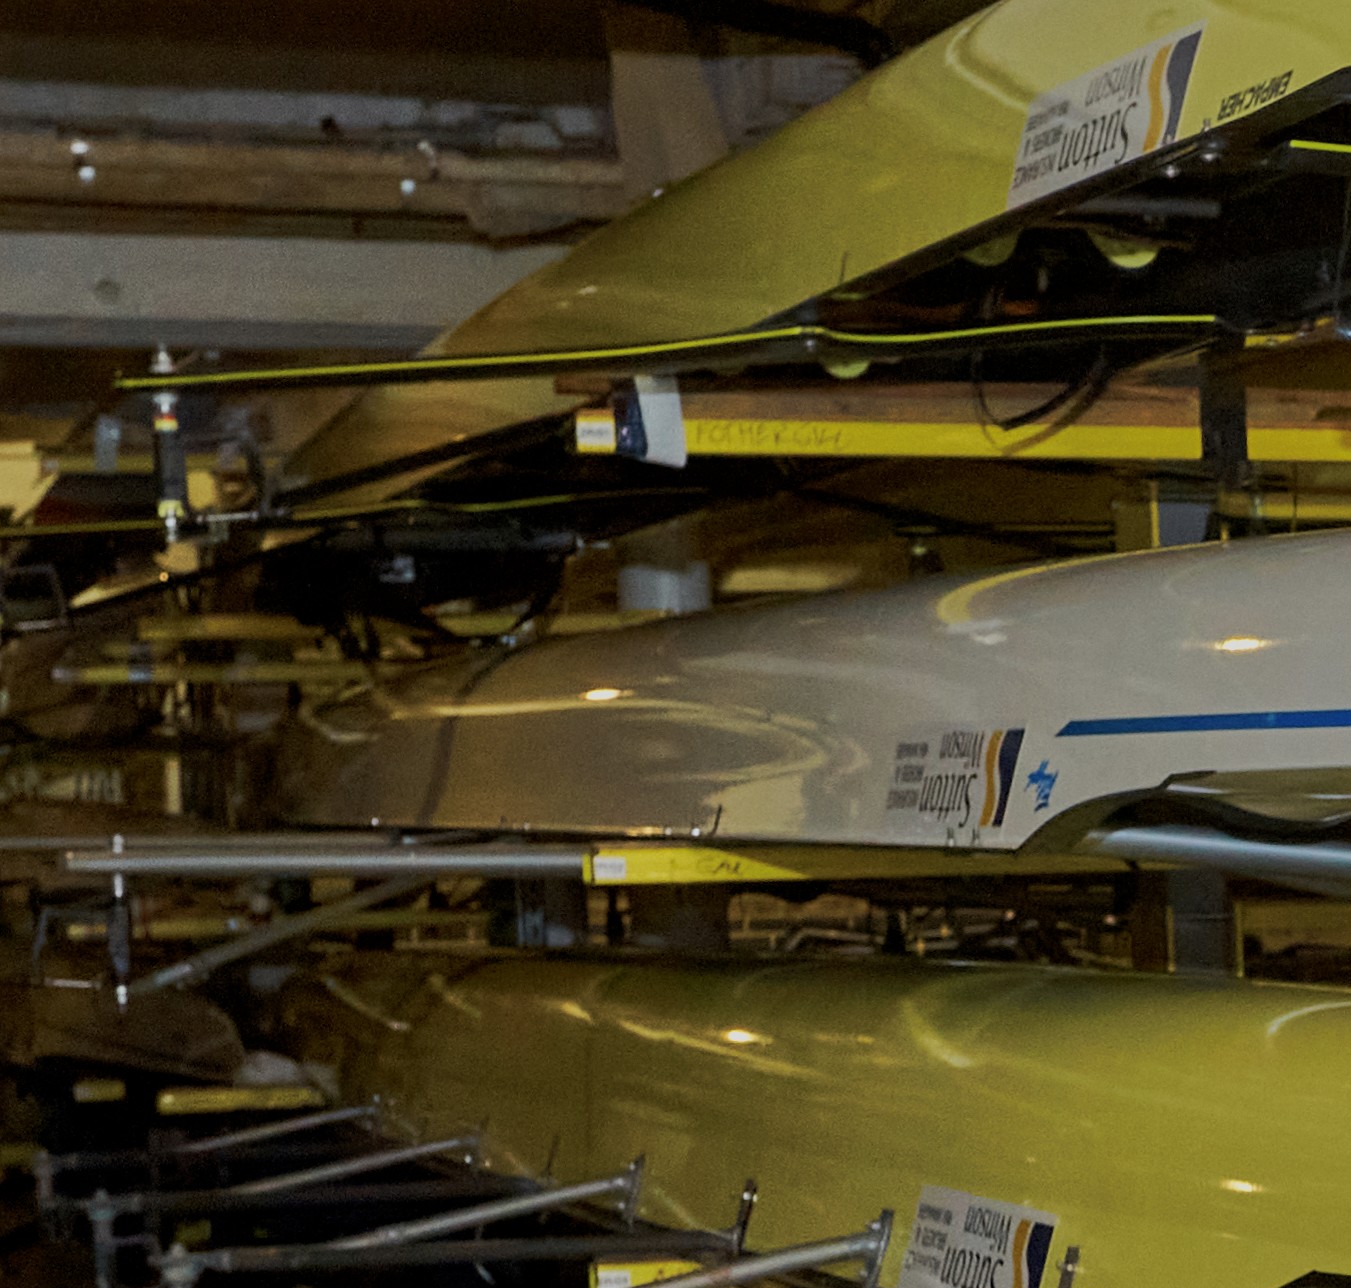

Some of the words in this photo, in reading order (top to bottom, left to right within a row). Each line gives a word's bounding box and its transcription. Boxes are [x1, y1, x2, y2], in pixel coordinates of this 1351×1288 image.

[1085, 56, 1147, 106] Winson
[1217, 69, 1293, 121] EMPACHER
[1057, 102, 1137, 173] Sutton
[918, 774, 978, 828] Sutton
[963, 1205, 1012, 1255] Winson
